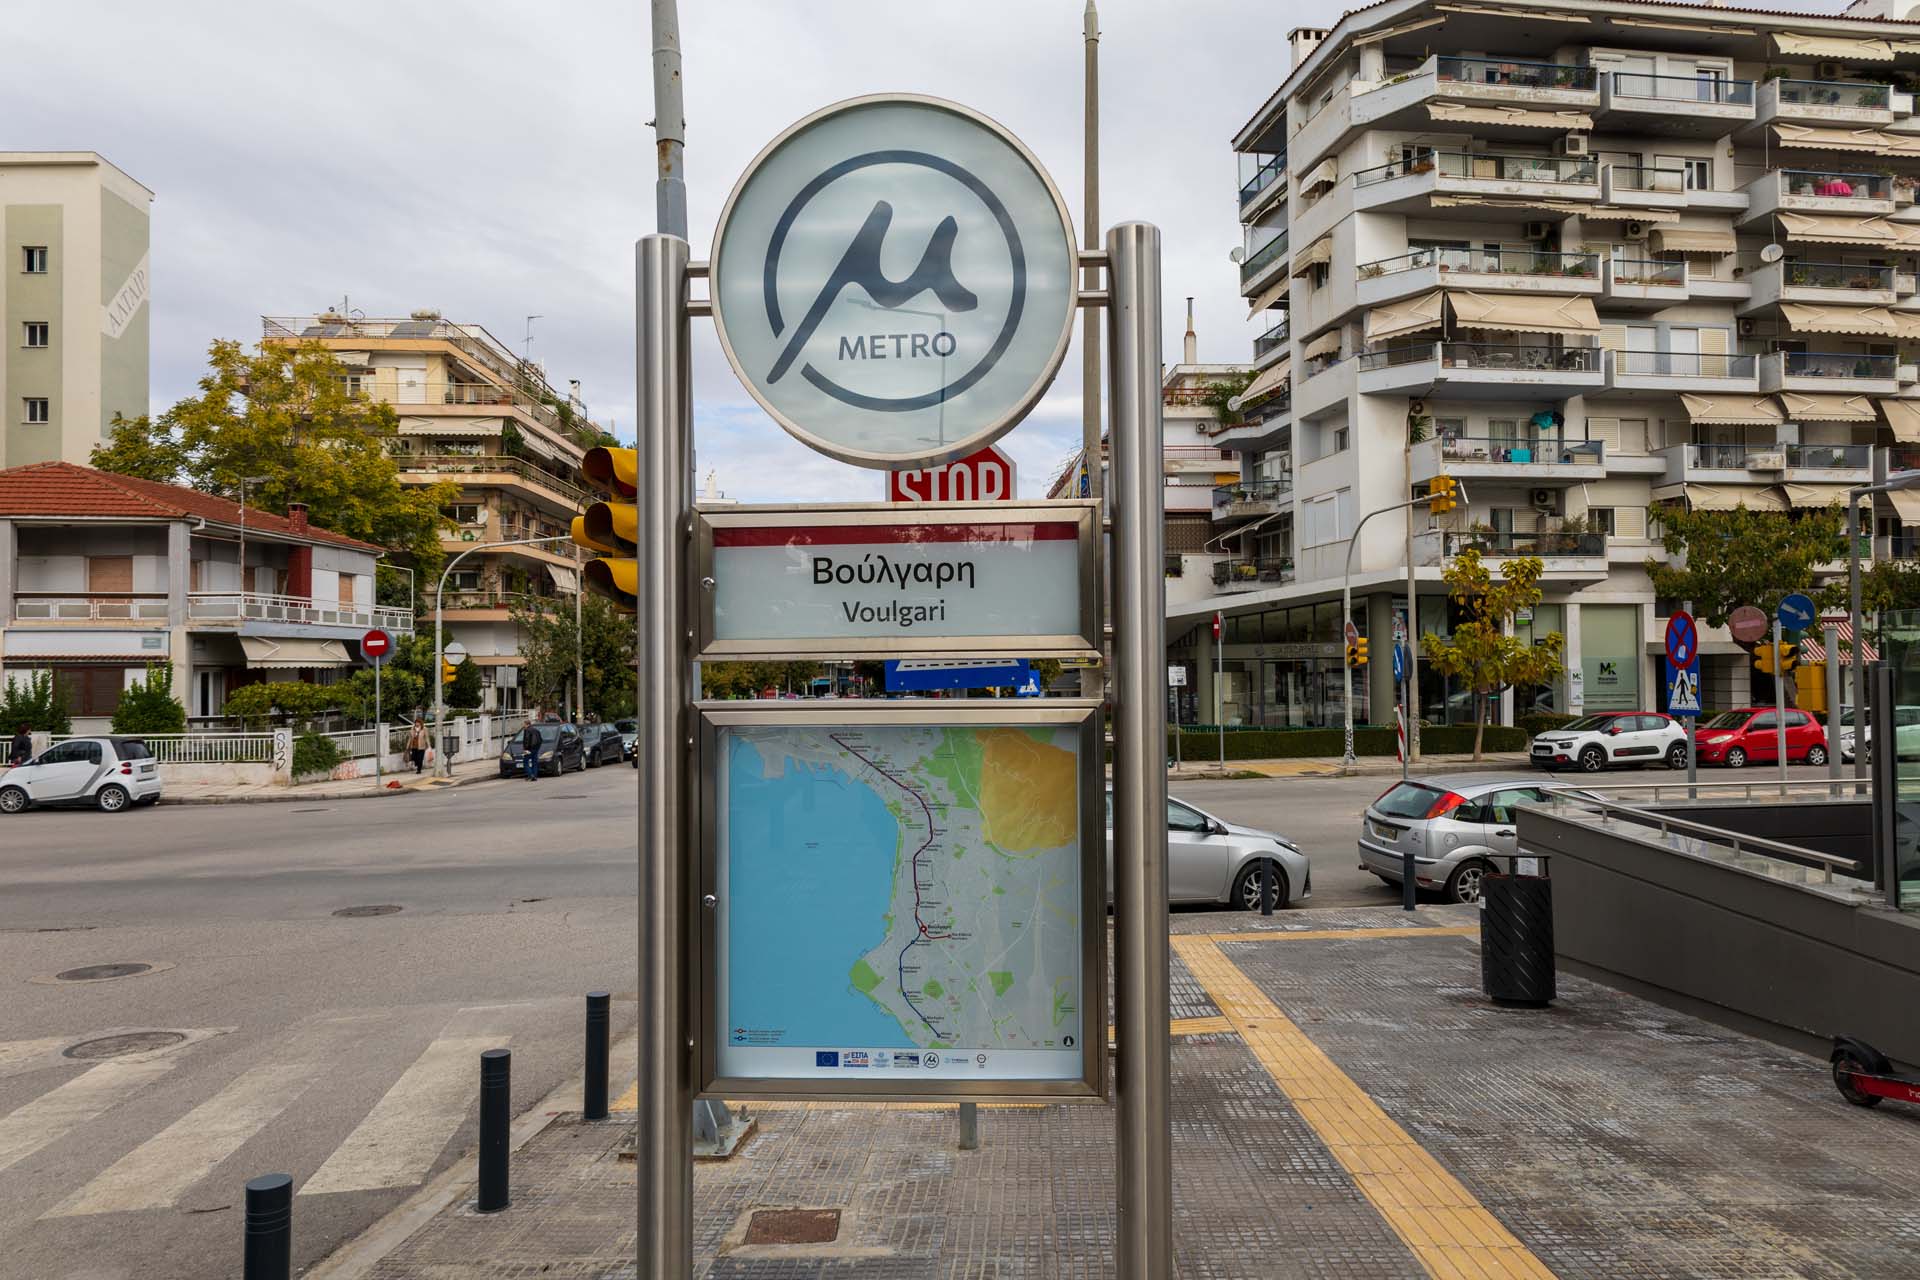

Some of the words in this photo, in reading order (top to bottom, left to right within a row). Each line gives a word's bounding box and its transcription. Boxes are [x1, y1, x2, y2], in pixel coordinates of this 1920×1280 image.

[838, 332, 957, 361] METRO
[898, 461, 1004, 502] STOP
[813, 553, 975, 590] Βούλγαρη
[842, 599, 946, 628] Voulgari
